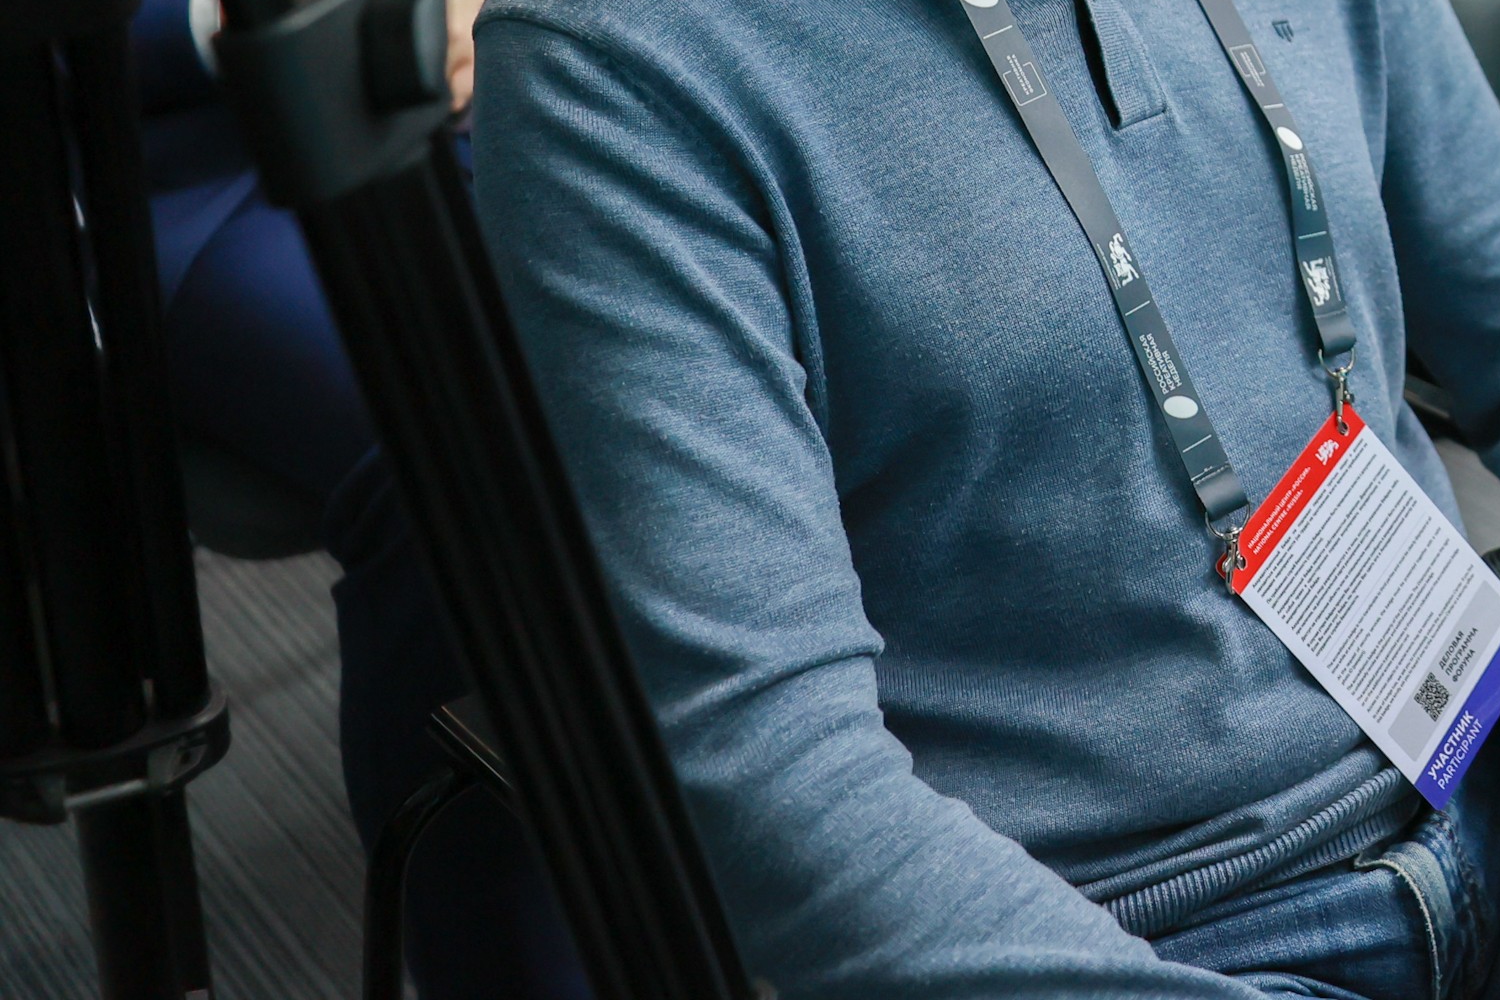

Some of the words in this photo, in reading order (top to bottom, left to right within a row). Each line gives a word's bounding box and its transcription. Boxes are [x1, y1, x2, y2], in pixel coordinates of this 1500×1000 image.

[1138, 333, 1170, 395] РОССИЙСКАЯ
[1145, 332, 1176, 391] КРЕАТИВНАЯ
[1160, 349, 1183, 387] НЕДЕЛЯ
[1278, 488, 1293, 507] ЦЕНТР
[1252, 527, 1274, 555] NATIONAL
[1270, 508, 1288, 531] CENTRE
[1437, 629, 1465, 670] ДЕЛОВАЯ
[1444, 625, 1478, 676] ПРОГРАММА
[1450, 646, 1476, 684] ФОРУМА
[1426, 708, 1475, 781] УЧАСТНИК
[1436, 717, 1484, 791] PARTICIPANT
